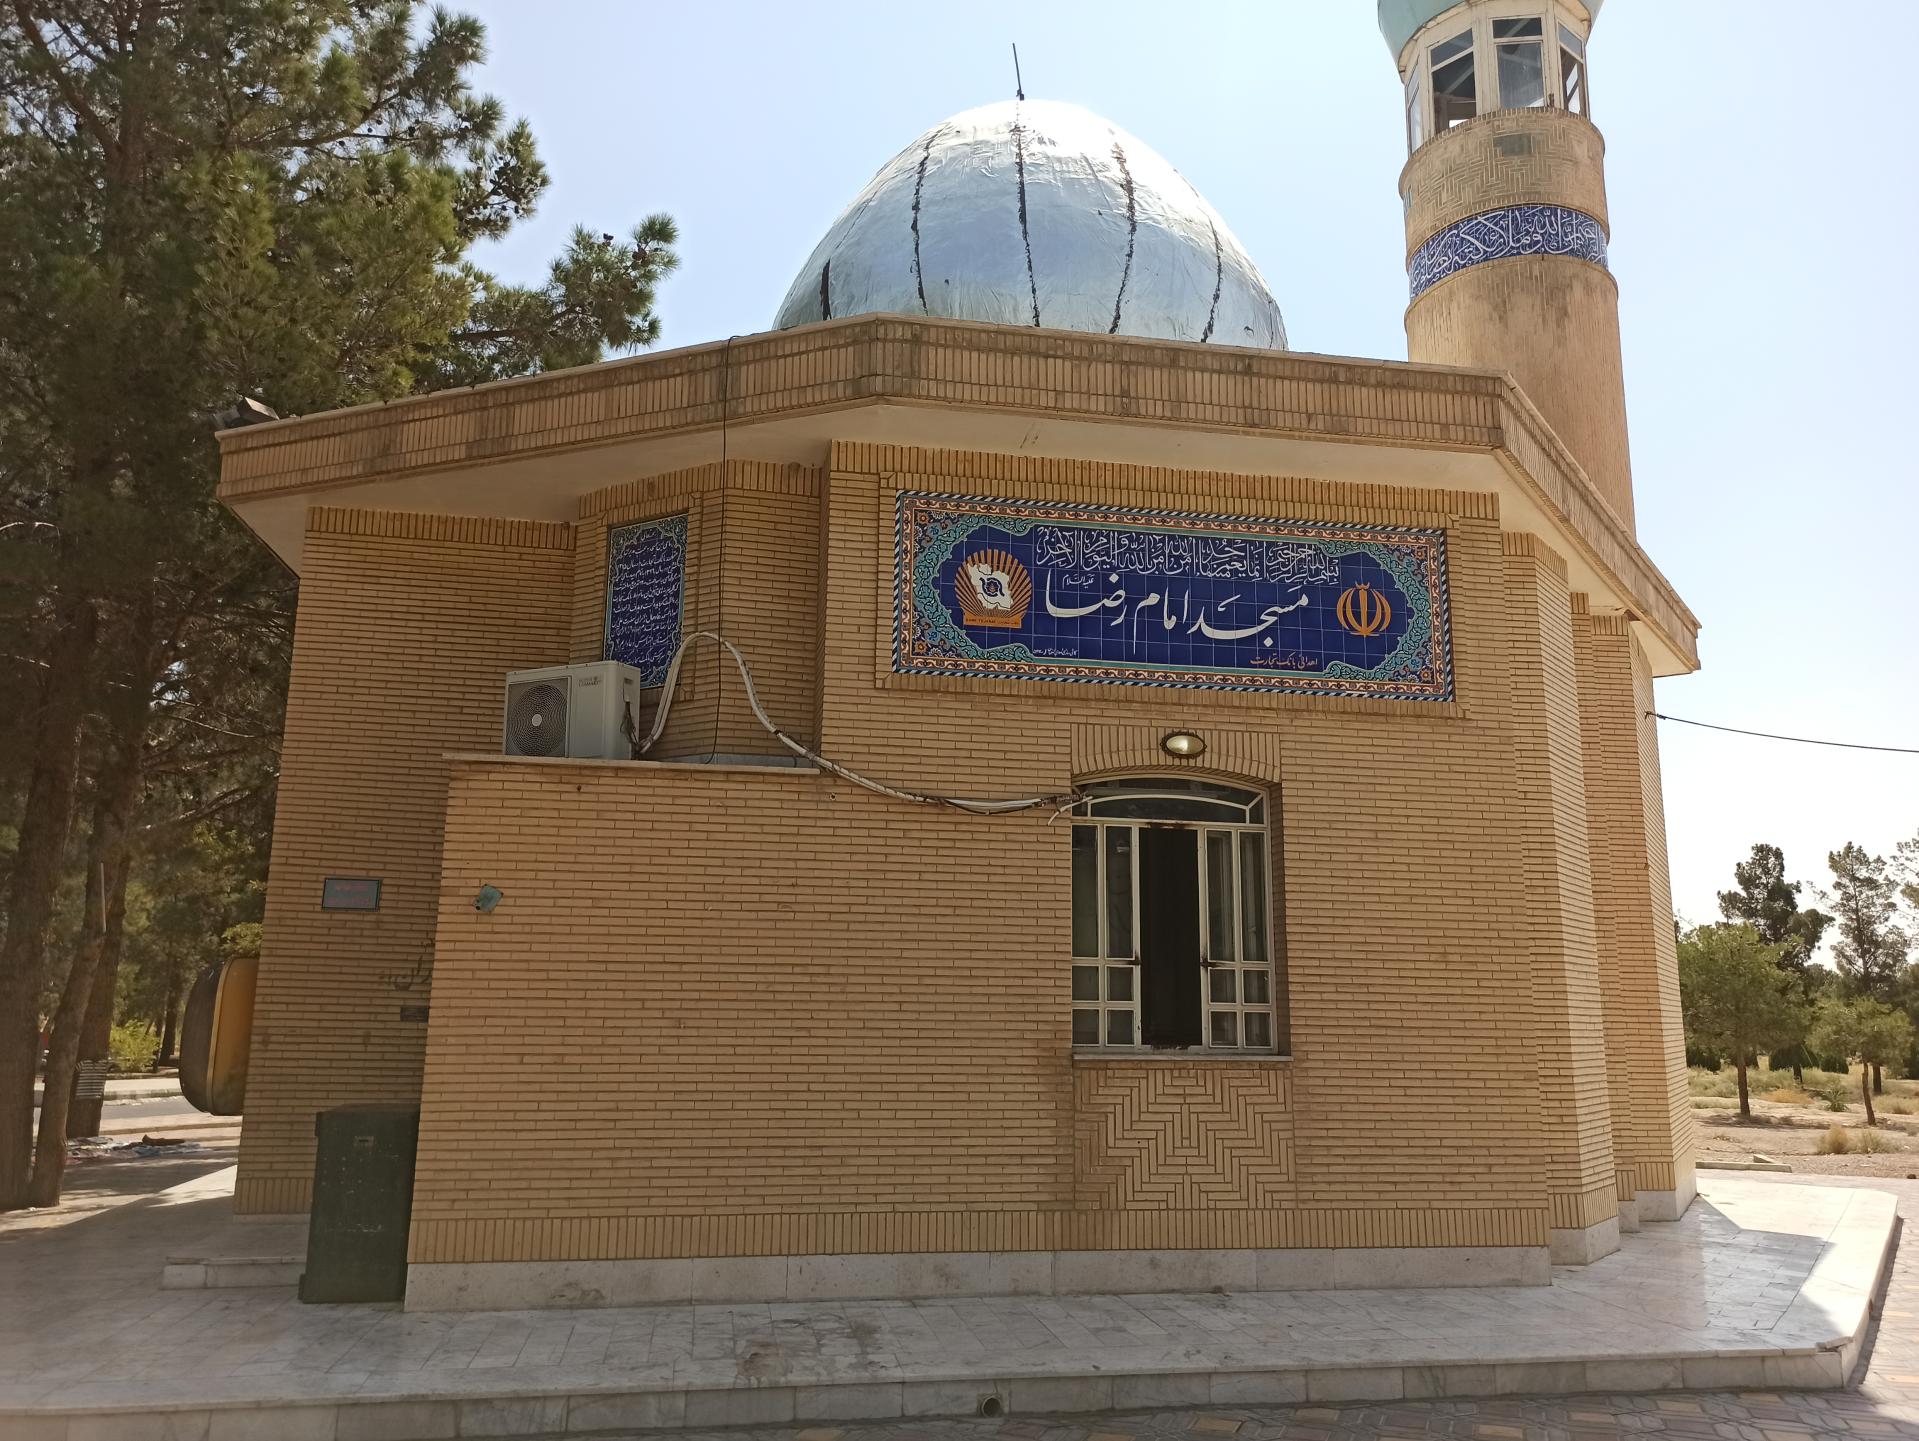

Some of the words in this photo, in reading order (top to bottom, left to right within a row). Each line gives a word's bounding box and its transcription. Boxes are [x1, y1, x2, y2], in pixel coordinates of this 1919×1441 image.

[1045, 569, 1128, 627] رضا
[1133, 586, 1189, 655] امام
[1187, 592, 1309, 648] مسجد
[1250, 653, 1278, 668] تجارت
[1277, 651, 1296, 669] بانک
